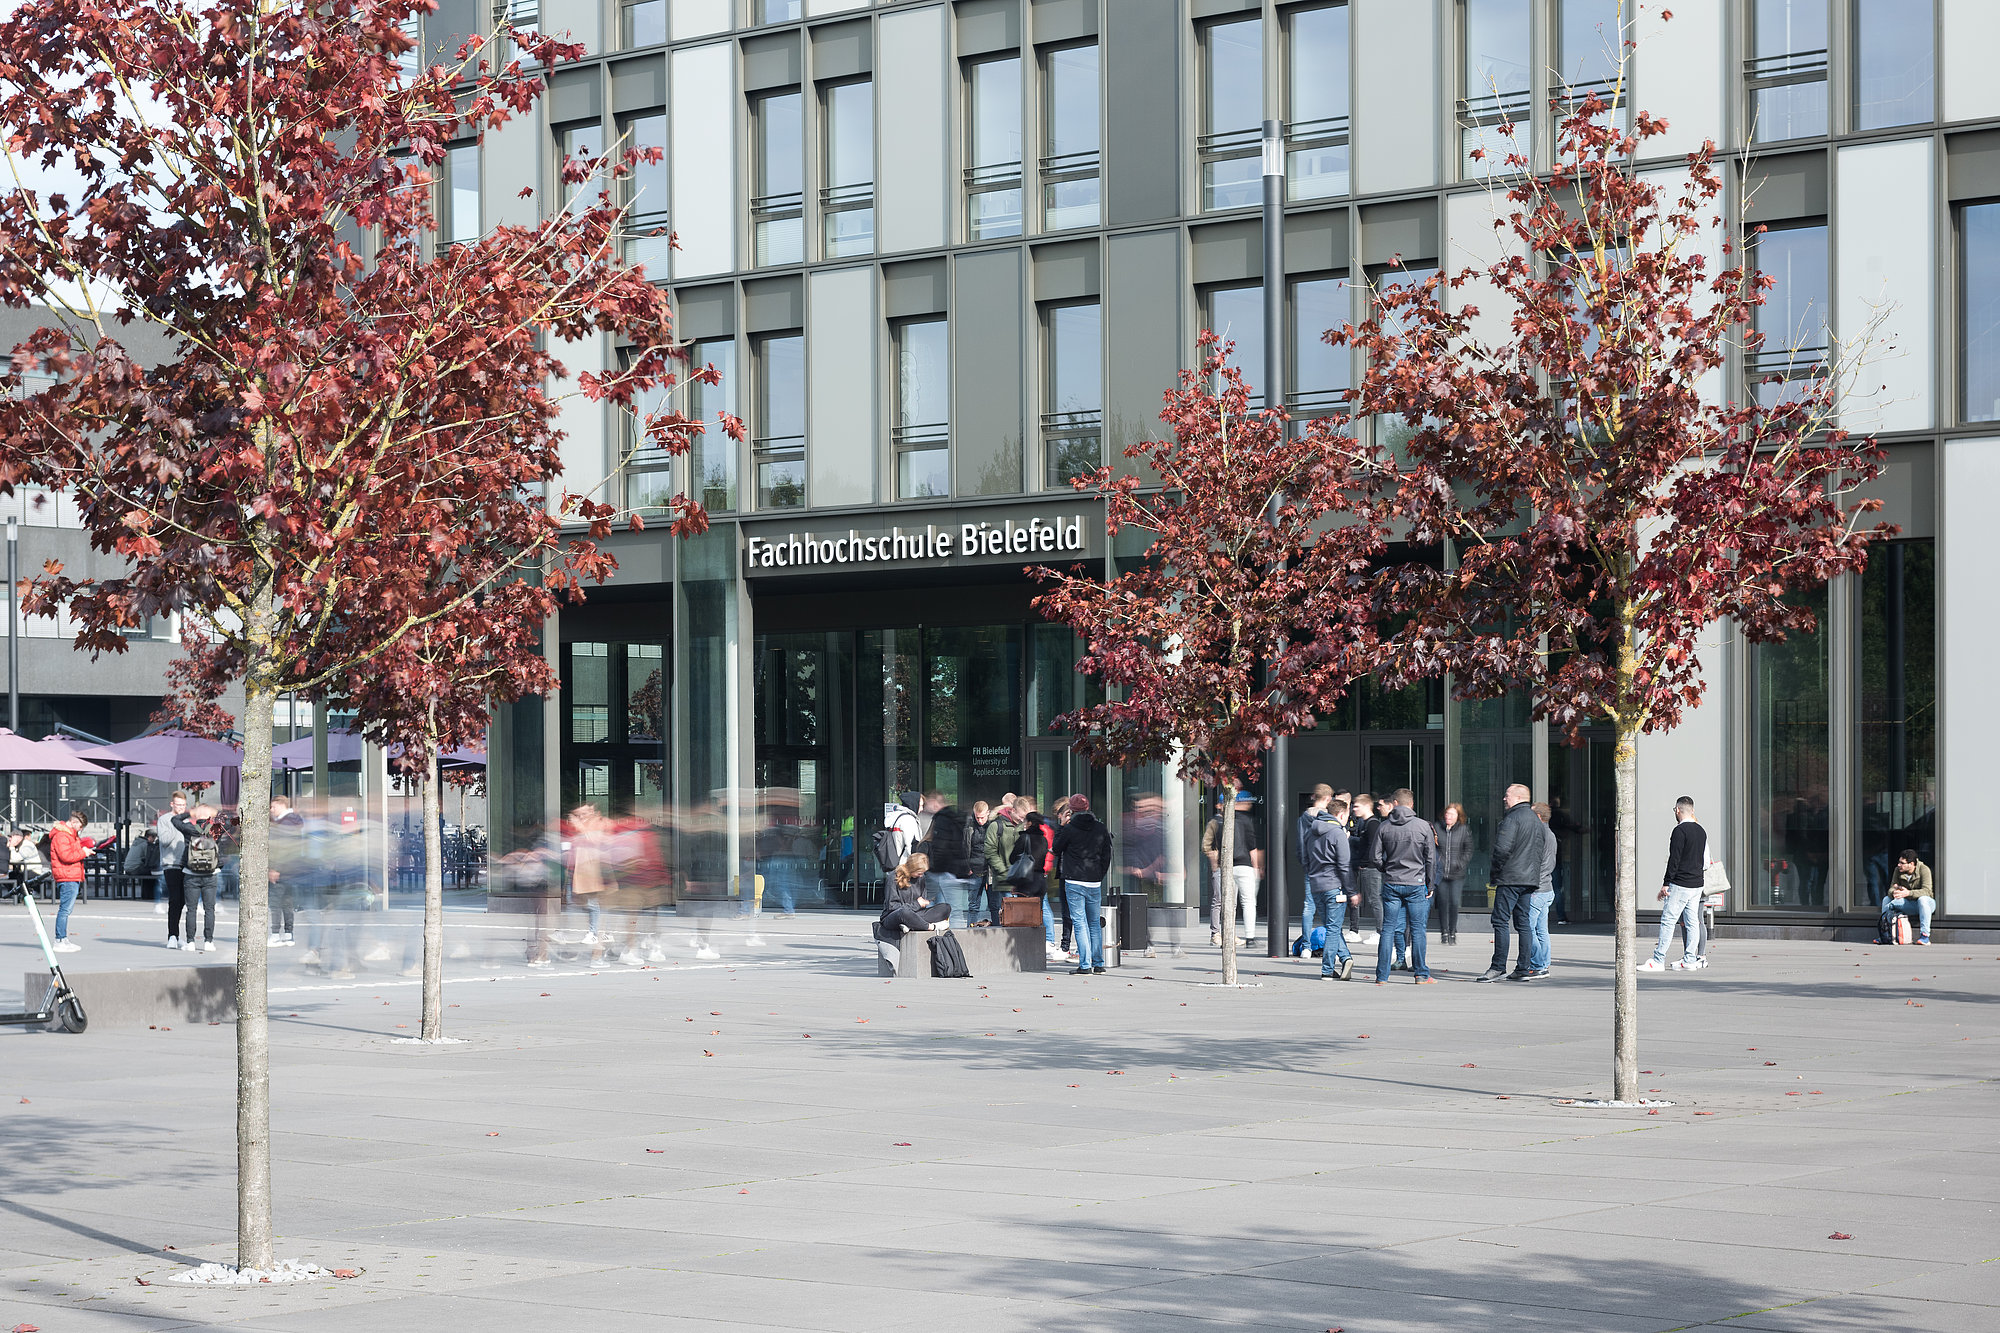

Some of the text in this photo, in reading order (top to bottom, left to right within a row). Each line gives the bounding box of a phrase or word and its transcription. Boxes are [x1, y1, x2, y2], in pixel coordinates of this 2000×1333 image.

[748, 514, 1082, 568] Fachhochschule Bielefeld
[972, 746, 1010, 755] FH Bielefeld
[972, 757, 1008, 766] University of
[972, 768, 1020, 777] Applied Sciences
